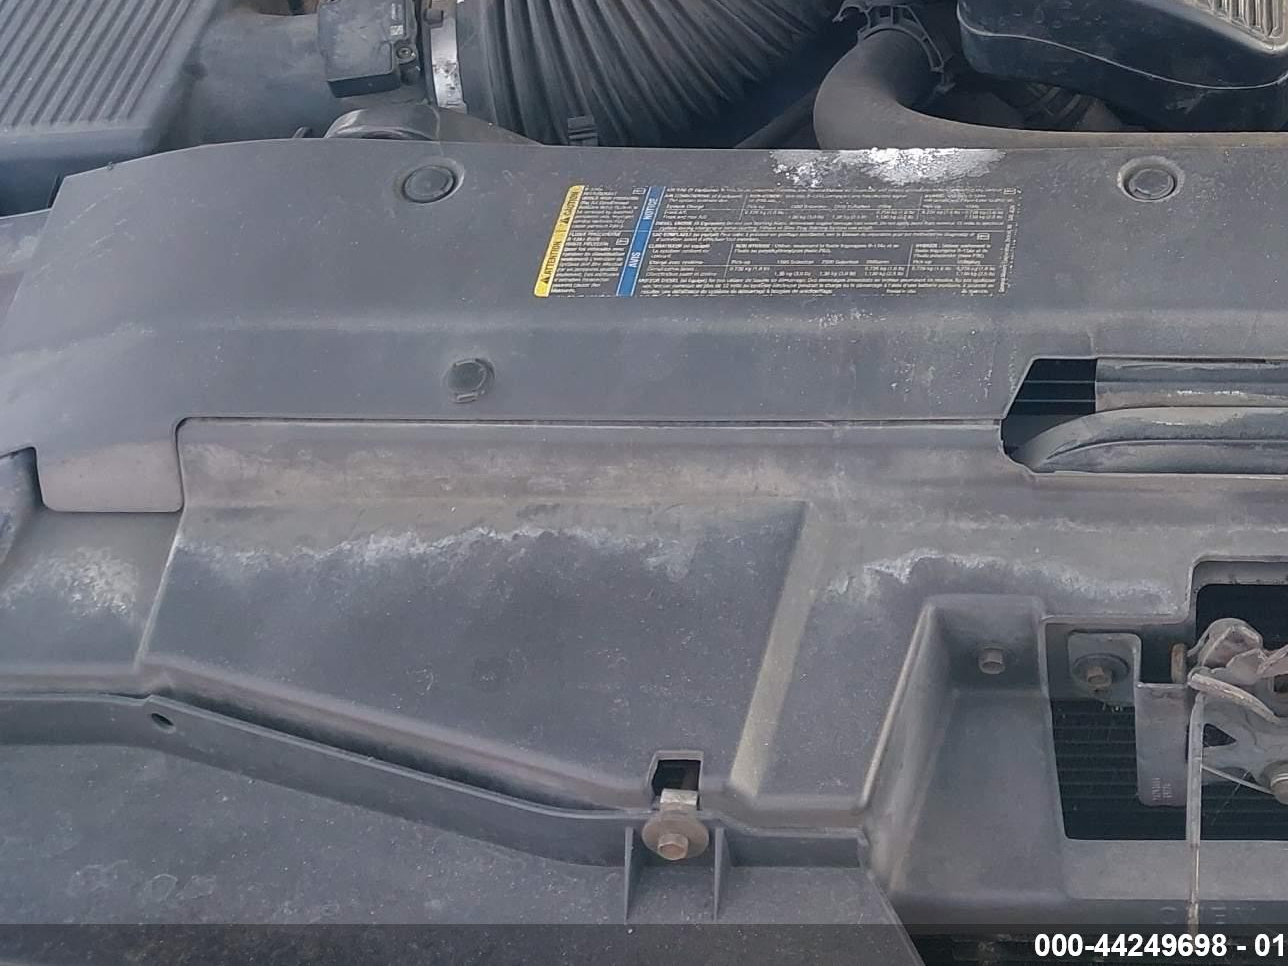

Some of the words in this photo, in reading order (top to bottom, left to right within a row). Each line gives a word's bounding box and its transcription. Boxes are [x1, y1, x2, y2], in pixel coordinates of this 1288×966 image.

[563, 191, 580, 217] CAUTION
[643, 197, 658, 220] NOTICE
[545, 240, 563, 278] ATTENTION
[628, 251, 641, 268] AVIS
